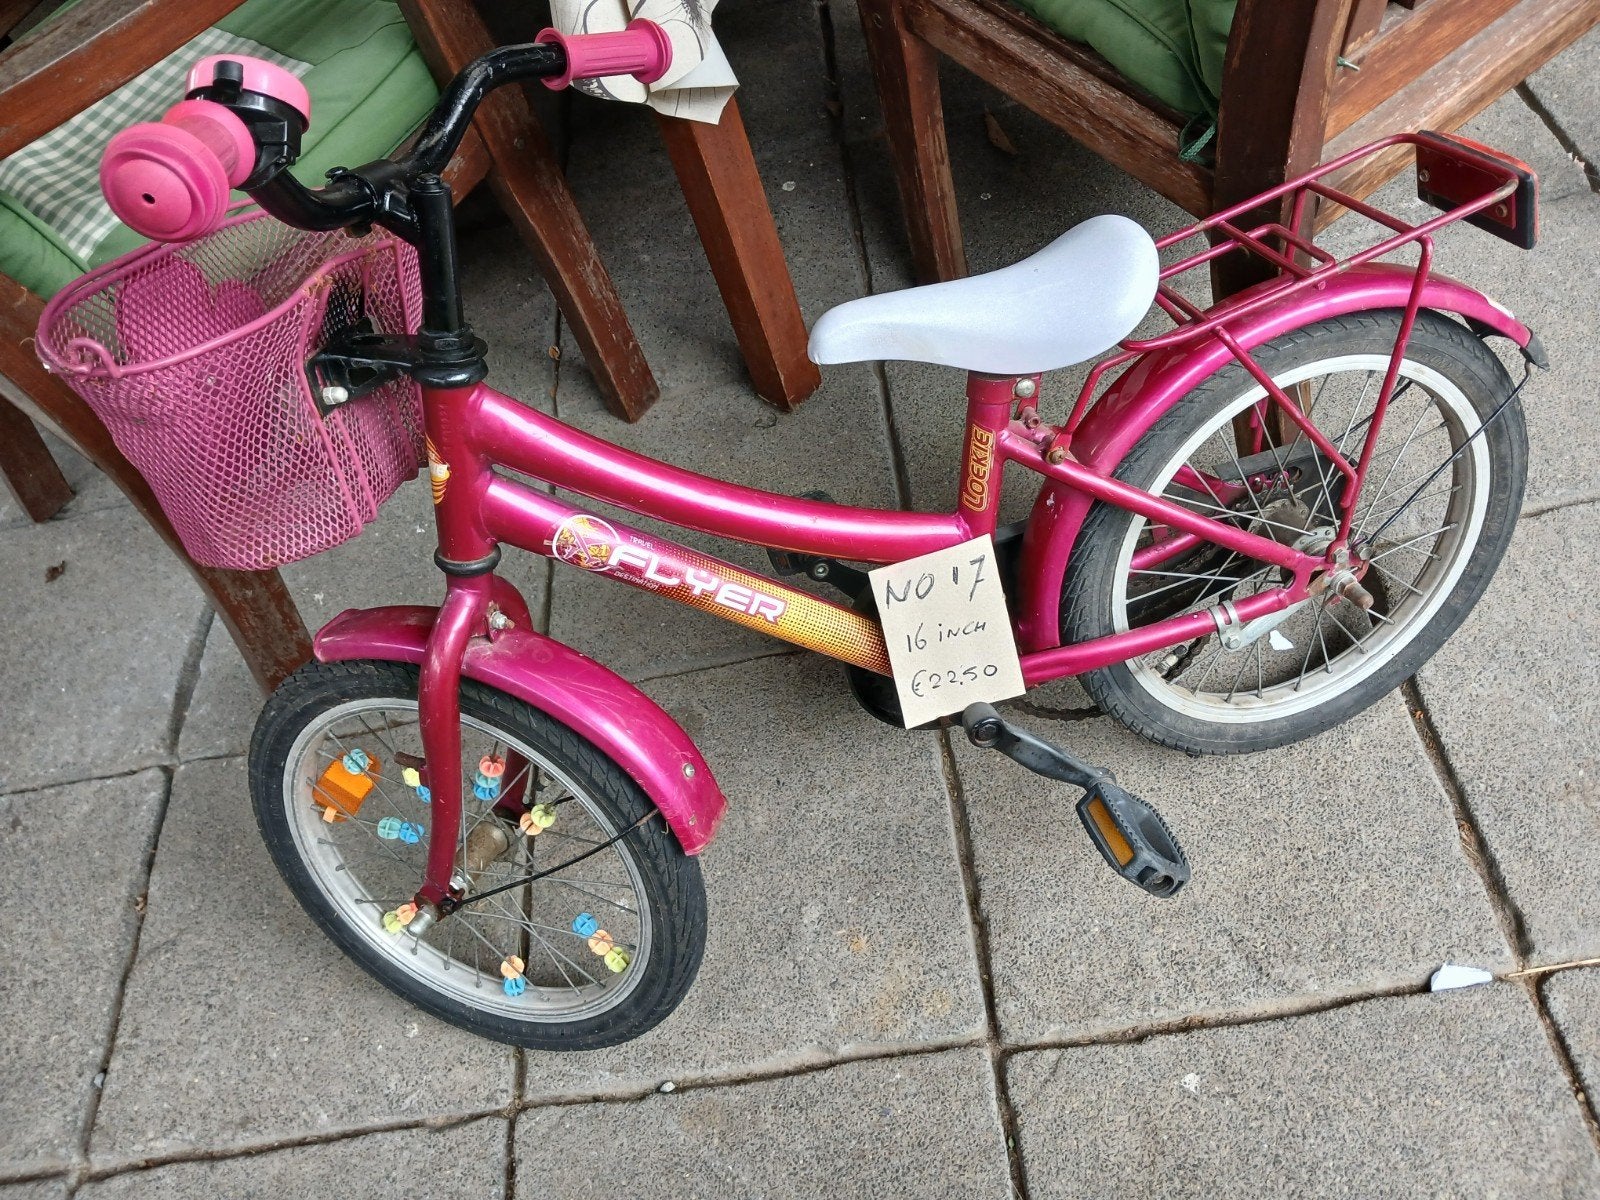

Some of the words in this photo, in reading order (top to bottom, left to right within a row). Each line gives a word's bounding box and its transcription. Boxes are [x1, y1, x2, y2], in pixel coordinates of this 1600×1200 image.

[962, 423, 993, 511] LOEKIE
[608, 546, 786, 621] FLYER
[885, 572, 935, 610] NO
[952, 554, 986, 602] 17
[906, 621, 927, 653] 16
[911, 663, 998, 698] €22.50
